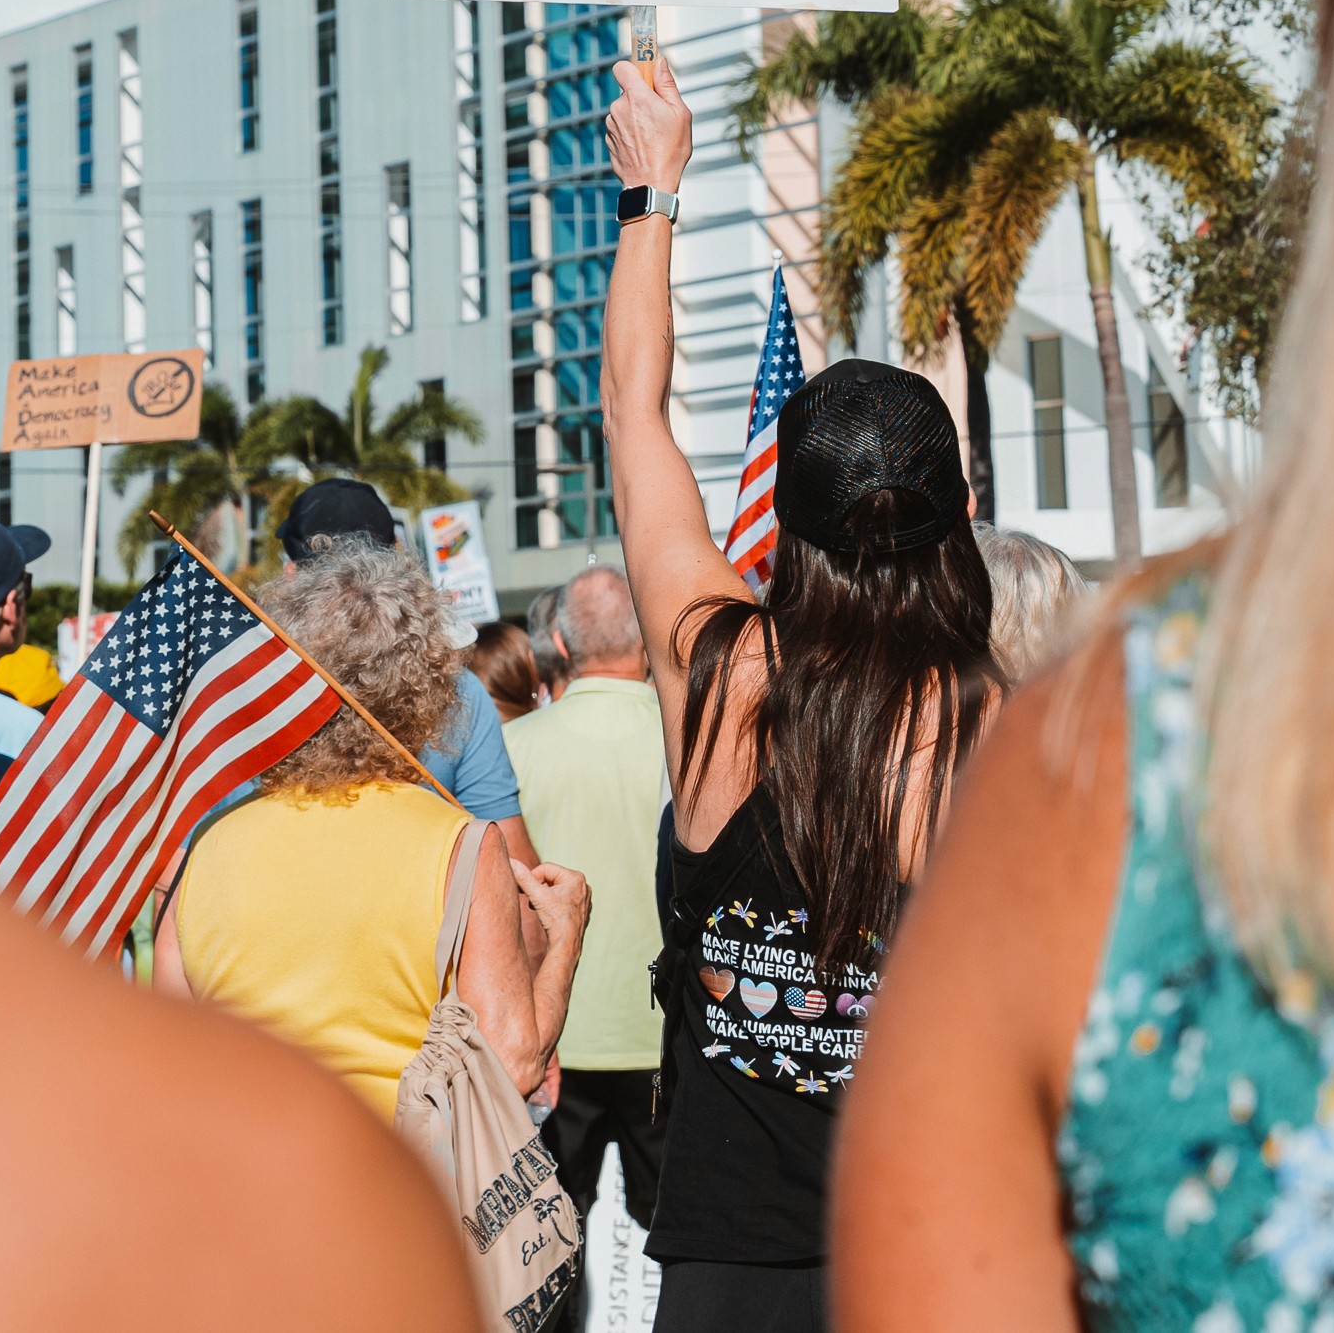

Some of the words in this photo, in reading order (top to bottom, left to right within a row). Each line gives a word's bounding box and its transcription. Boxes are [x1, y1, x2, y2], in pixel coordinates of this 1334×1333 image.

[18, 380, 99, 400] America
[19, 364, 76, 383] Make
[18, 404, 112, 427] Democracy
[702, 931, 741, 956] MAKE
[744, 943, 797, 965] LYING
[702, 947, 739, 968] MAKE
[741, 959, 816, 984] AMERICA
[707, 1004, 735, 1021] MAK
[743, 1019, 806, 1037] UMANS
[754, 1034, 814, 1052] EOPLE
[522, 1233, 551, 1266] Est.
[607, 1217, 631, 1333] SISTANCE
